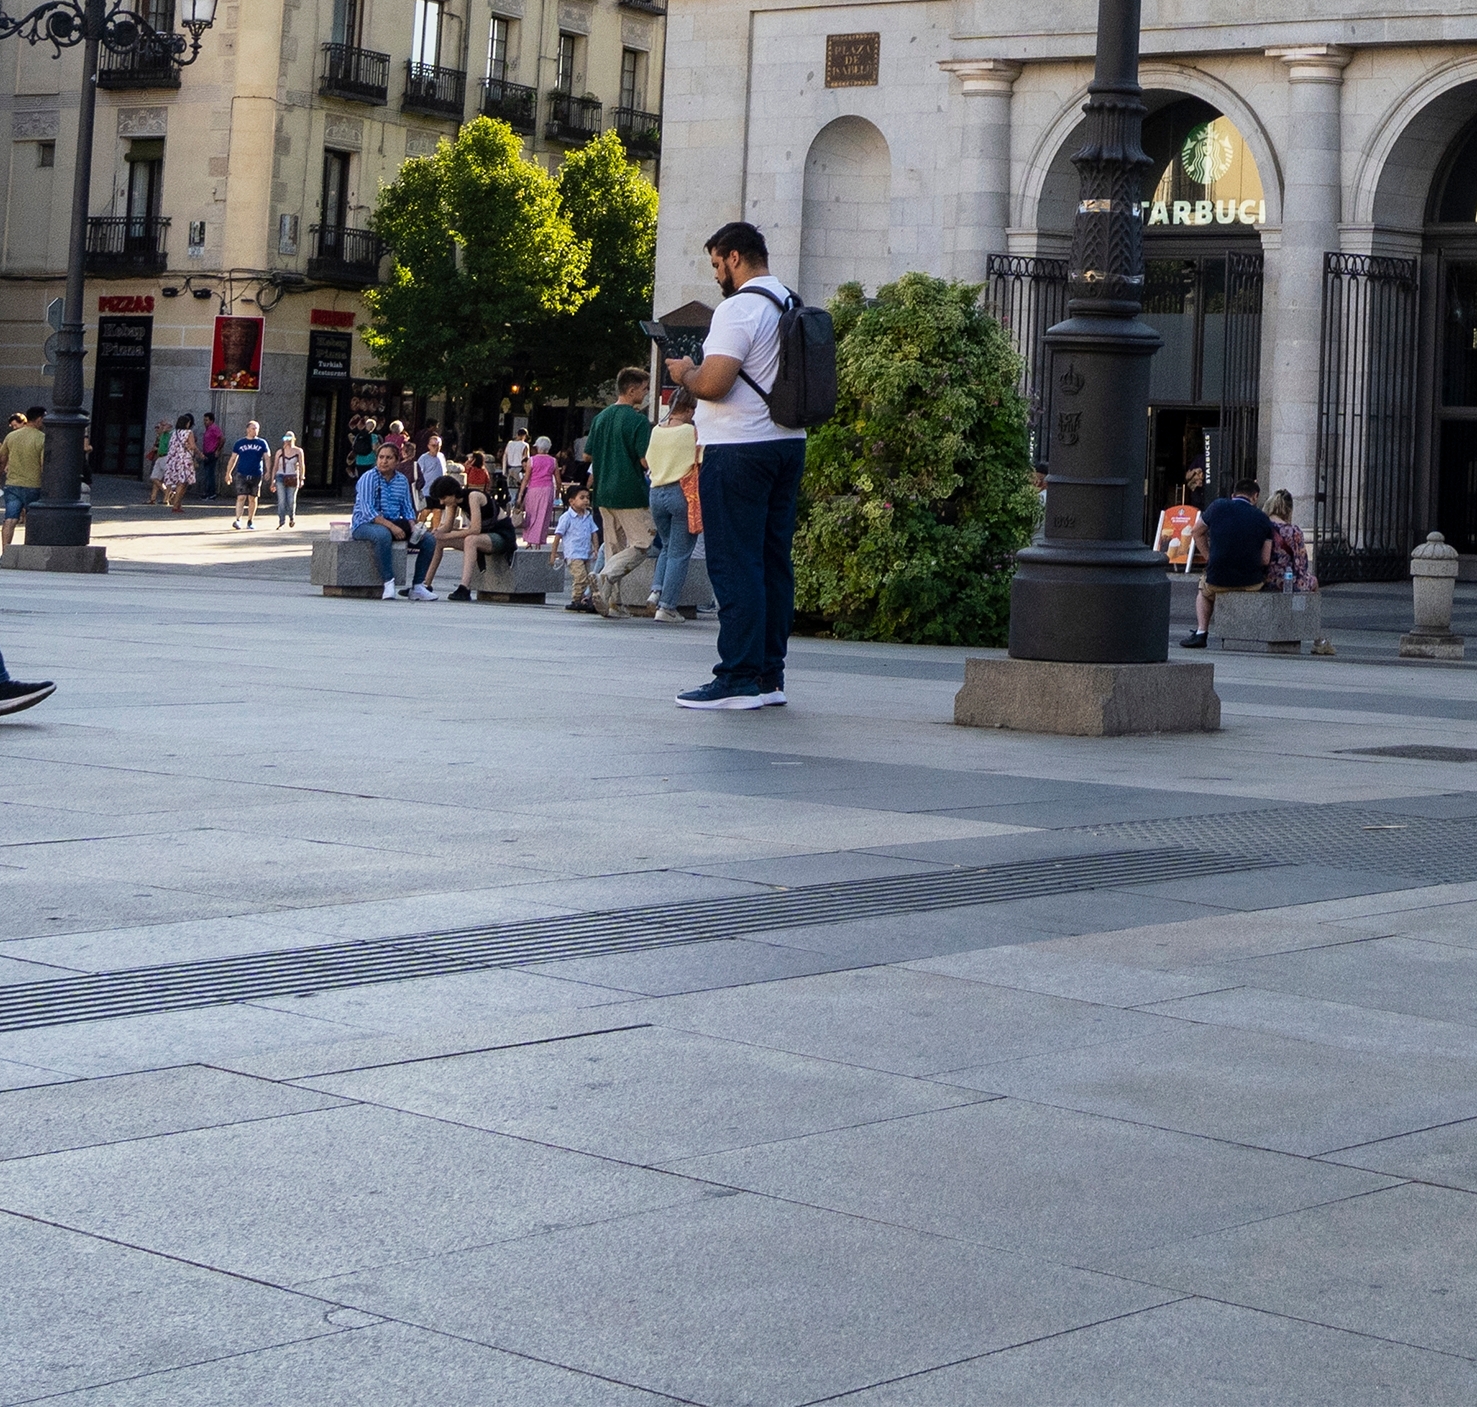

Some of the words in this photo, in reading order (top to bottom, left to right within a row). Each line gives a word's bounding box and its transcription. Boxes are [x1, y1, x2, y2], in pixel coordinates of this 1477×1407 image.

[318, 360, 343, 368] Turkish
[313, 368, 347, 377] Restaurant
[239, 443, 262, 451] TOMMY
